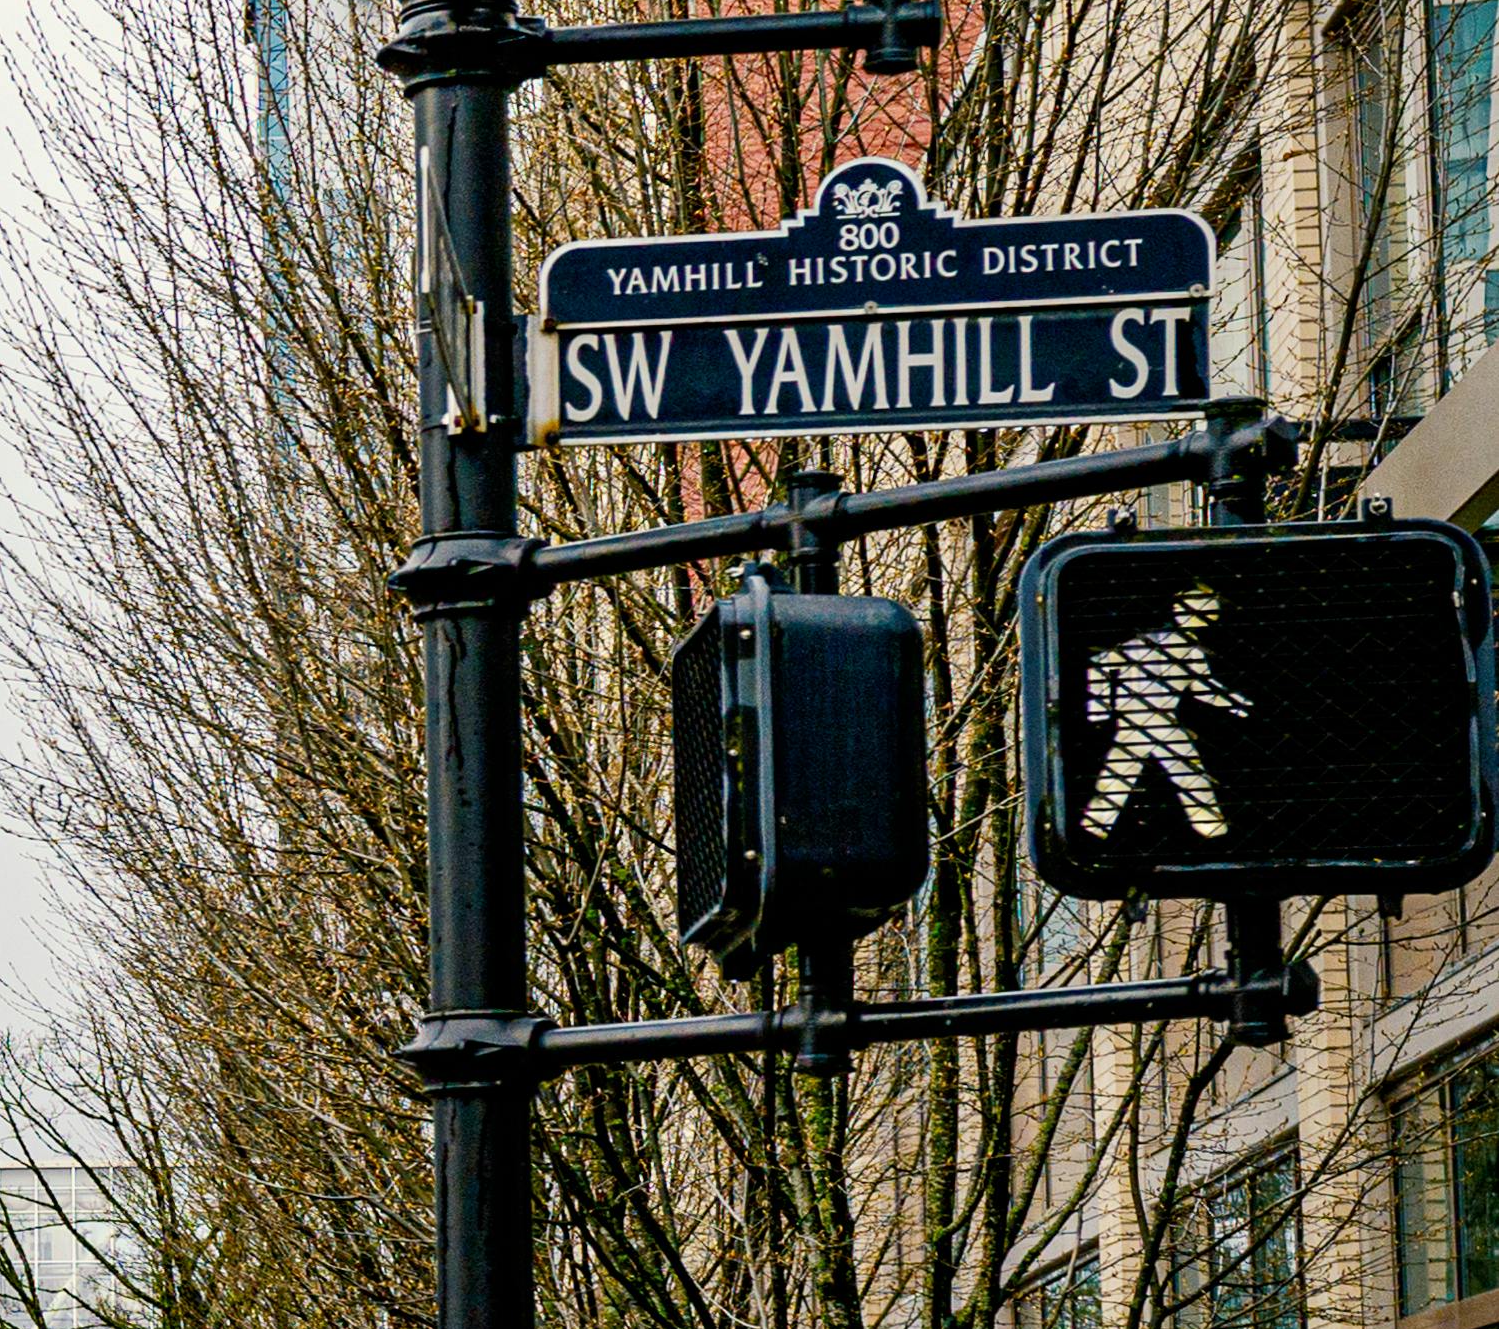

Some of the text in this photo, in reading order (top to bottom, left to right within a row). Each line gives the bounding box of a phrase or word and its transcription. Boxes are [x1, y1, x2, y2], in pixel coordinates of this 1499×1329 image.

[838, 221, 901, 252] 800
[606, 238, 1144, 296] YAMHILL HISTORIC DISTRICT
[564, 305, 1192, 423] SW YAMHILL ST
